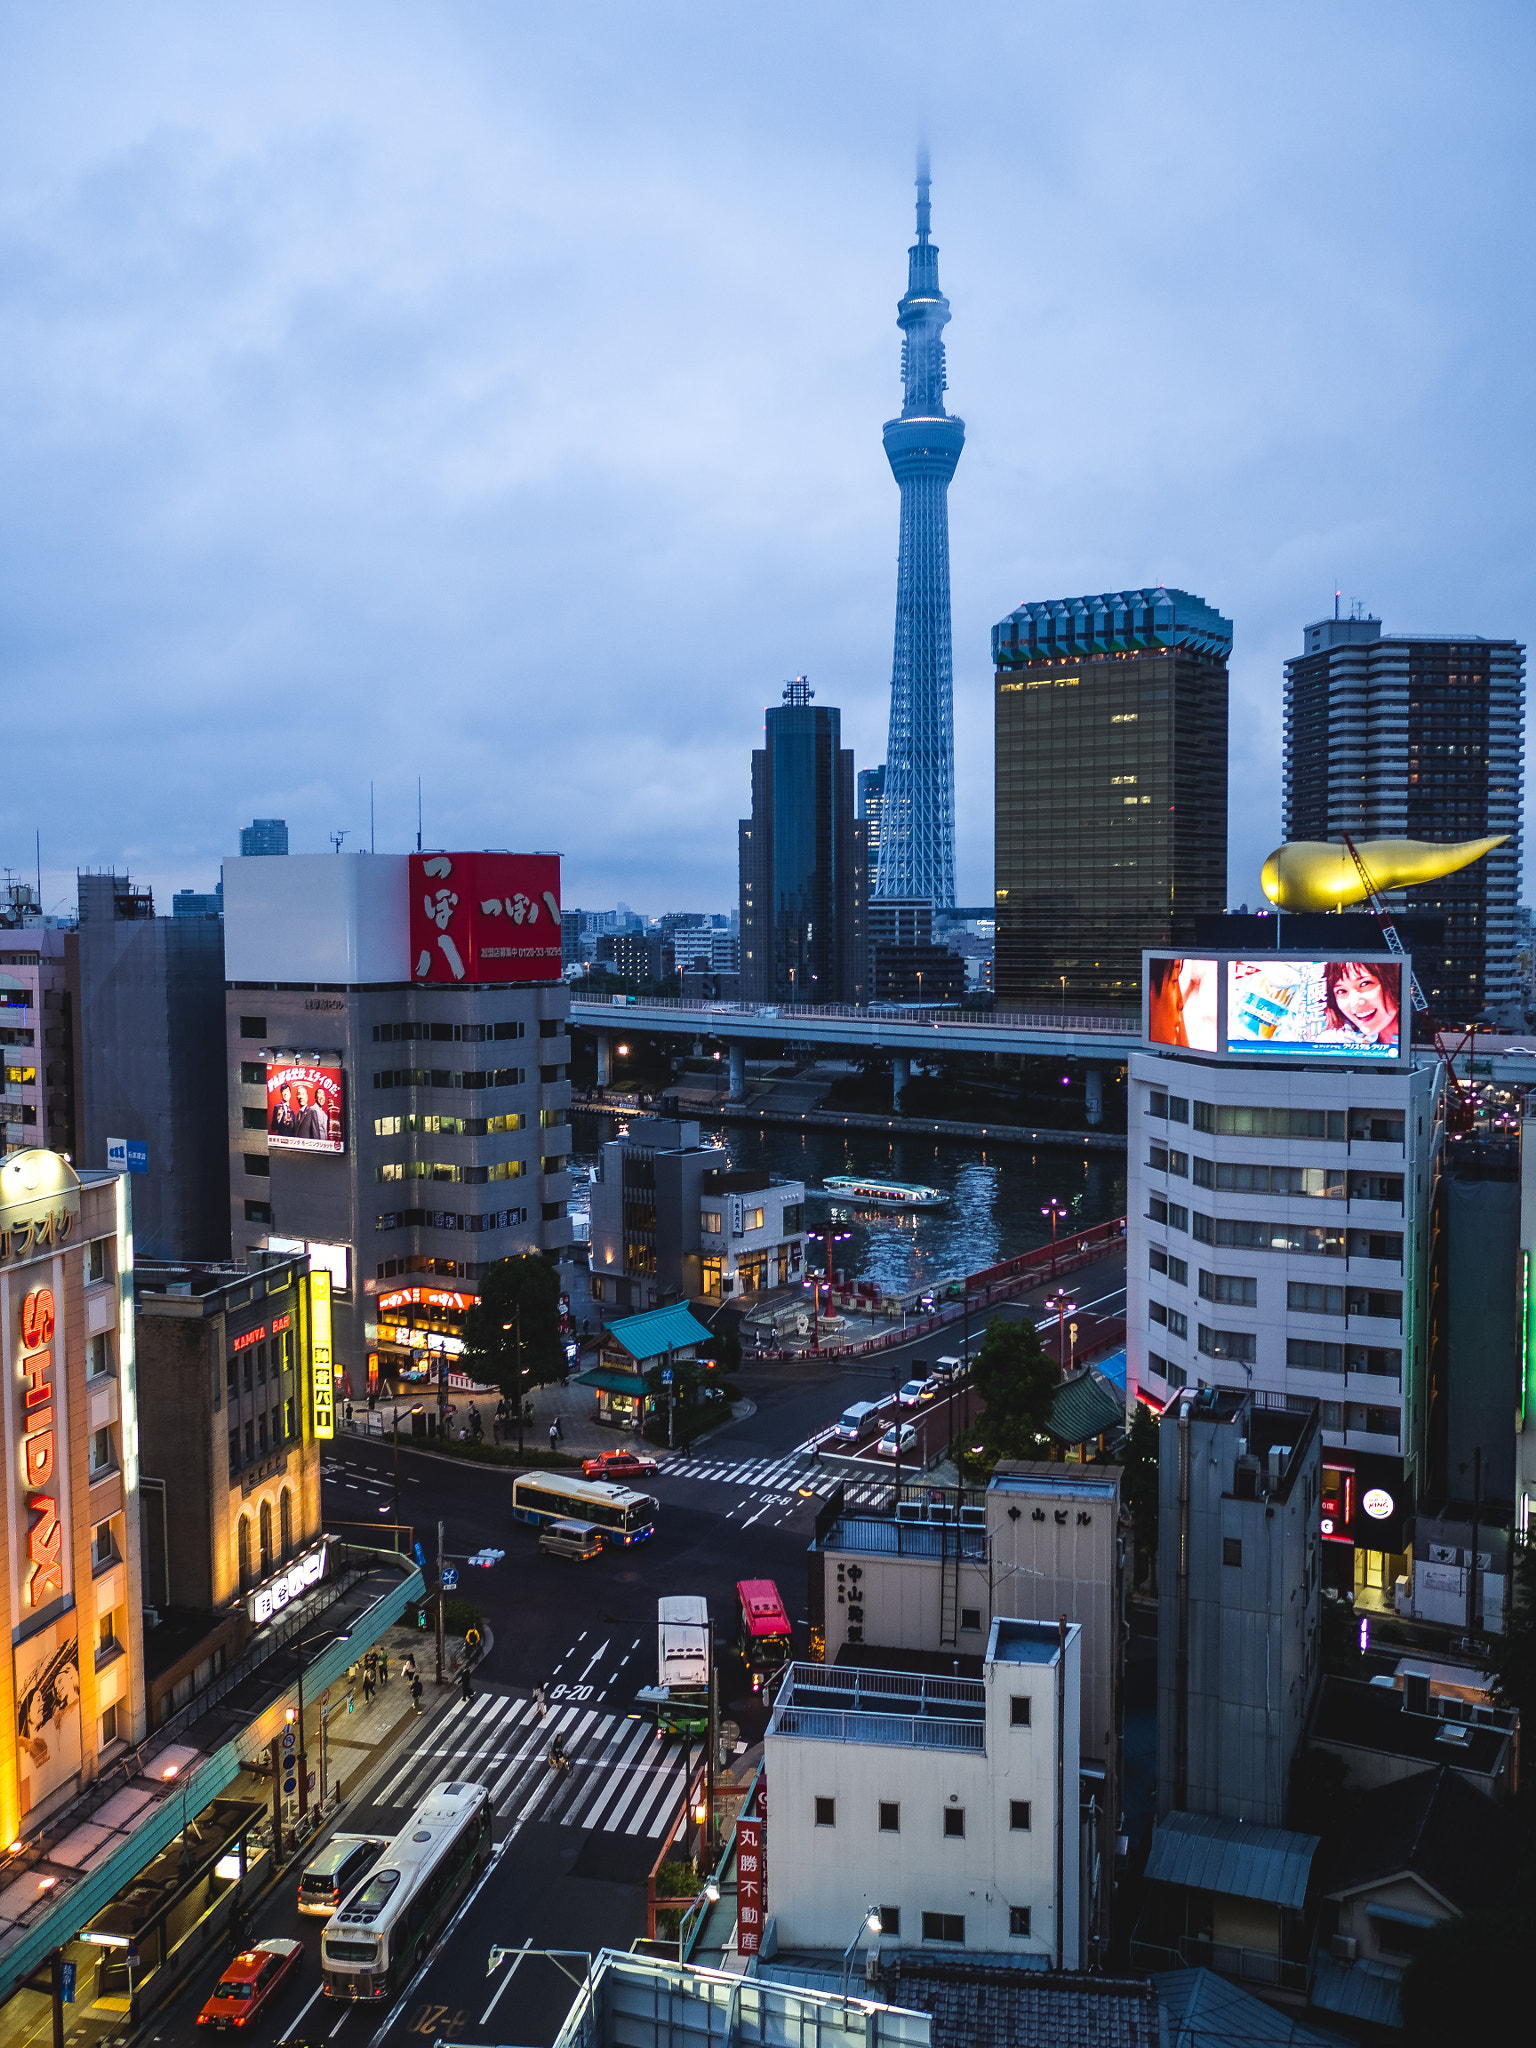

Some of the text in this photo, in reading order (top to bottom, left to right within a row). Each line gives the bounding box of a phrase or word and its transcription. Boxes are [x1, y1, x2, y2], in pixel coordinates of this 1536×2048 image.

[233, 1314, 291, 1351] KAMIYA BAR
[22, 1287, 63, 1608] SHIDAX
[1007, 1505, 1092, 1527] 中山ビル
[549, 1683, 595, 1701] 8-20
[740, 1828, 759, 1950] 丸勝不動産
